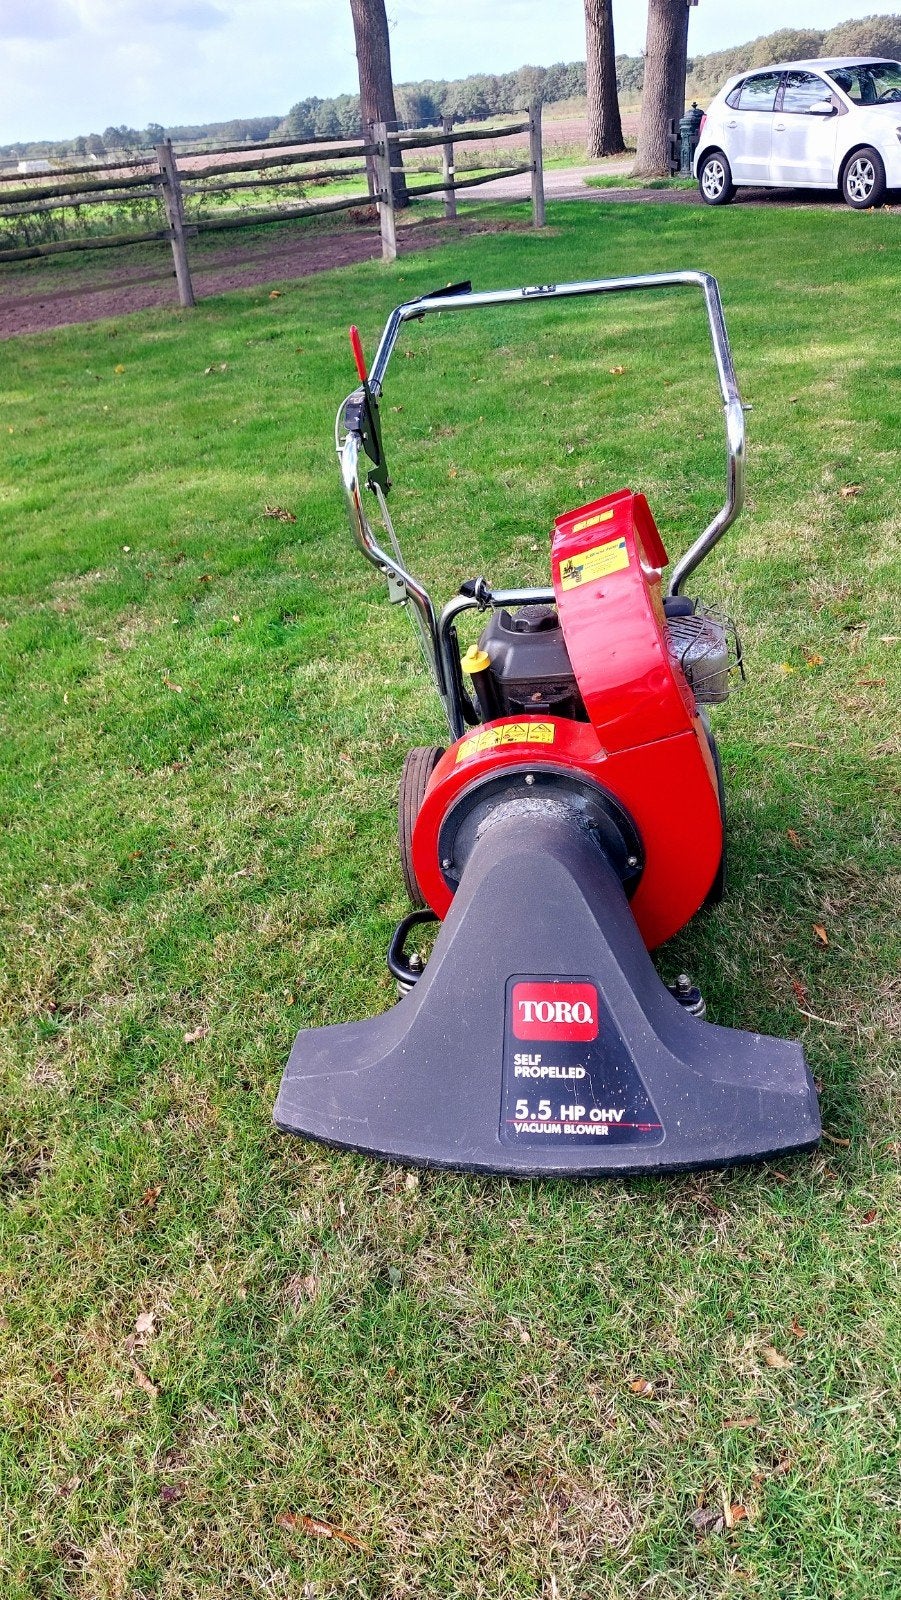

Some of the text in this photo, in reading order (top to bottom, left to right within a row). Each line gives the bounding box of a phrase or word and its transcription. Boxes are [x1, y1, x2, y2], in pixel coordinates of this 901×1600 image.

[513, 1054, 542, 1066] SELF
[514, 1066, 586, 1079] PROPELLED
[515, 1099, 625, 1122] 5.5 HP OHV
[514, 1123, 609, 1136] VACUUM BLOWER
